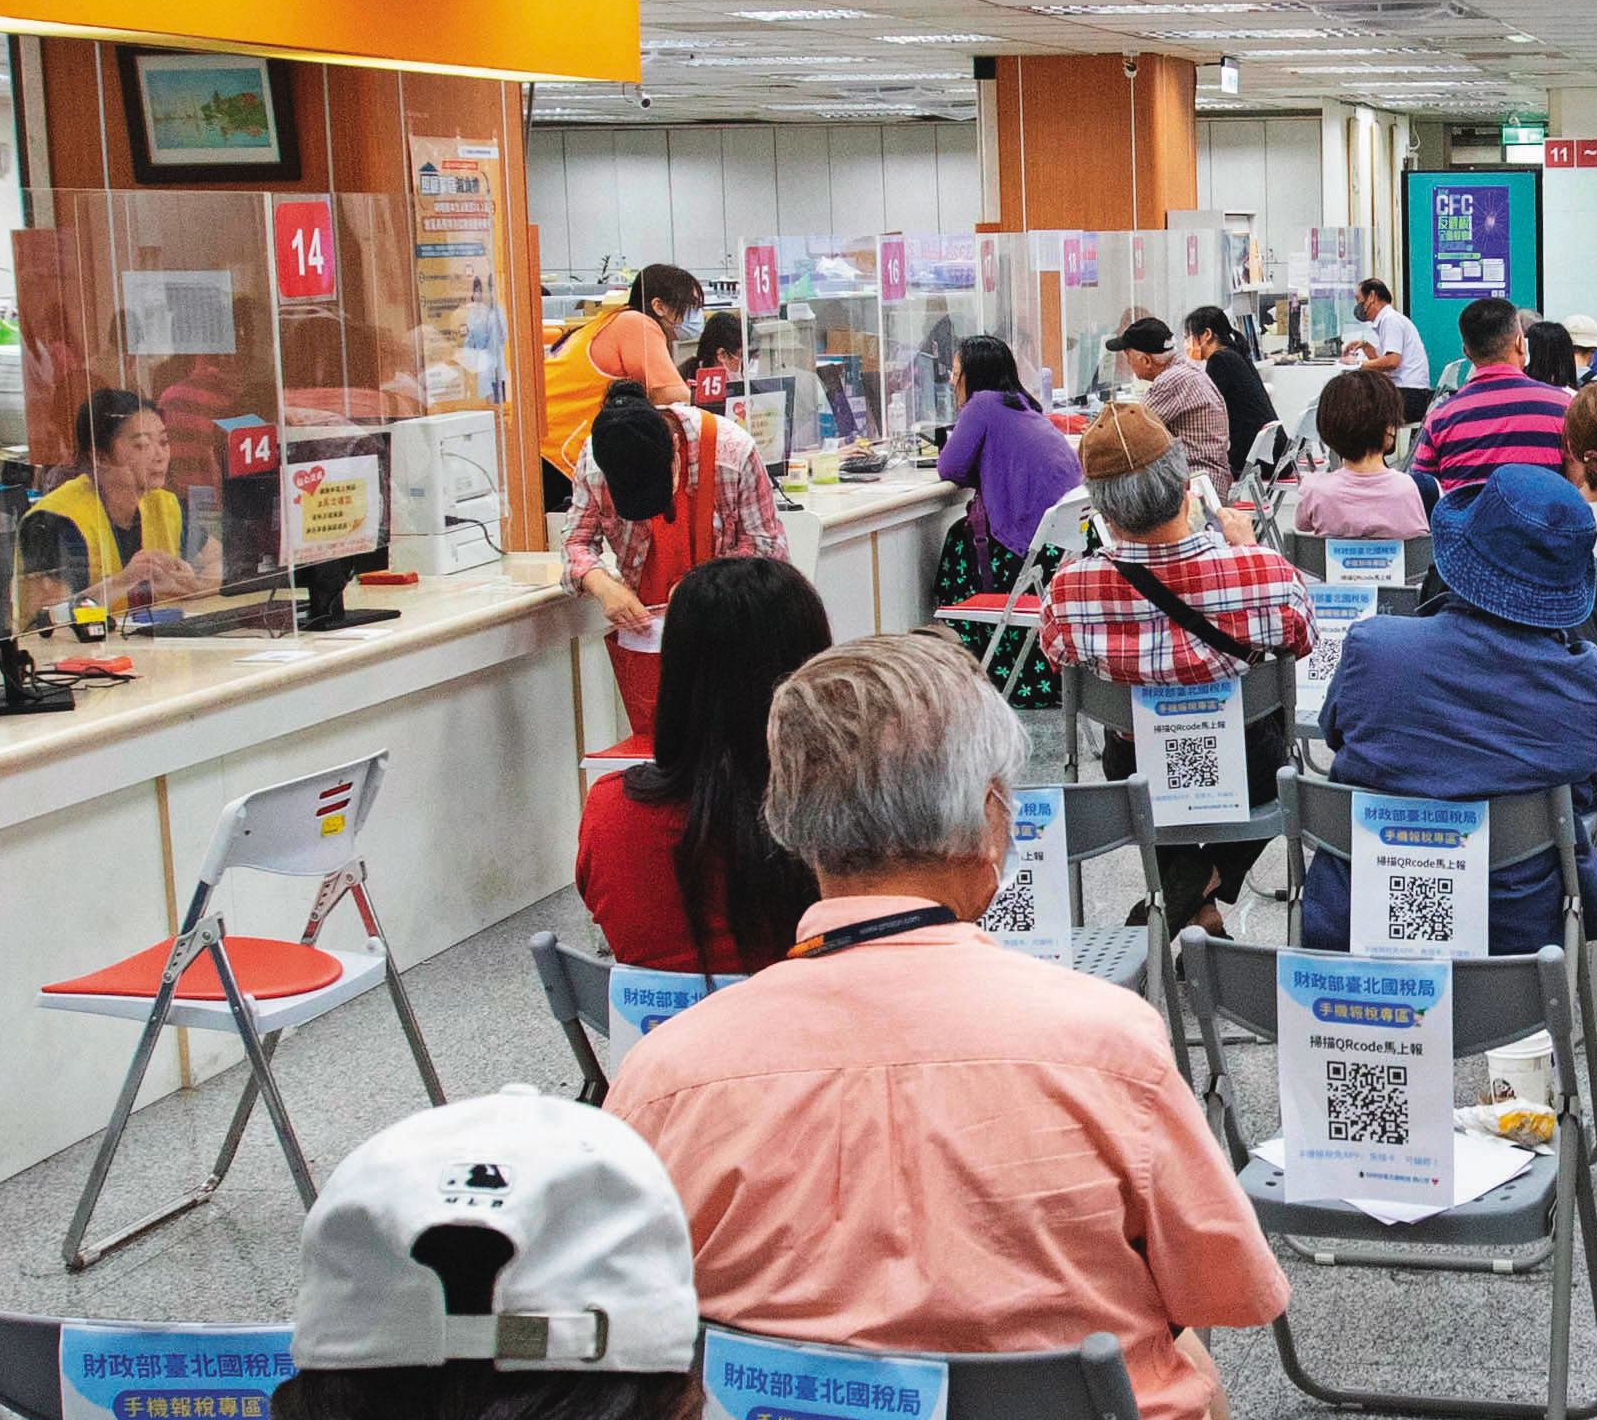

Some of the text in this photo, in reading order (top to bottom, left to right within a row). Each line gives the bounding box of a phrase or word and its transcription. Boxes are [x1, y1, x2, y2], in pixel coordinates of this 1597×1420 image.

[1550, 148, 1568, 162] 11
[1436, 194, 1473, 215] CFC
[291, 226, 324, 277] 14
[753, 265, 770, 293] 15
[887, 258, 900, 284] 16
[701, 376, 723, 396] 15
[240, 435, 271, 465] 14
[1364, 807, 1477, 825] 財政部臺北國稅局
[1376, 855, 1466, 871] 掃描QRcode馬上報
[1294, 971, 1435, 997] 財政部臺北國稅局
[1319, 1002, 1411, 1024] 手機報稅專區
[1310, 1035, 1423, 1056] 掃描QRcode馬上報
[82, 1351, 296, 1382] 財政部臺北國稅局
[723, 1360, 922, 1418] 財政部臺北國稅局
[124, 1396, 265, 1420] 手機報稅專區
